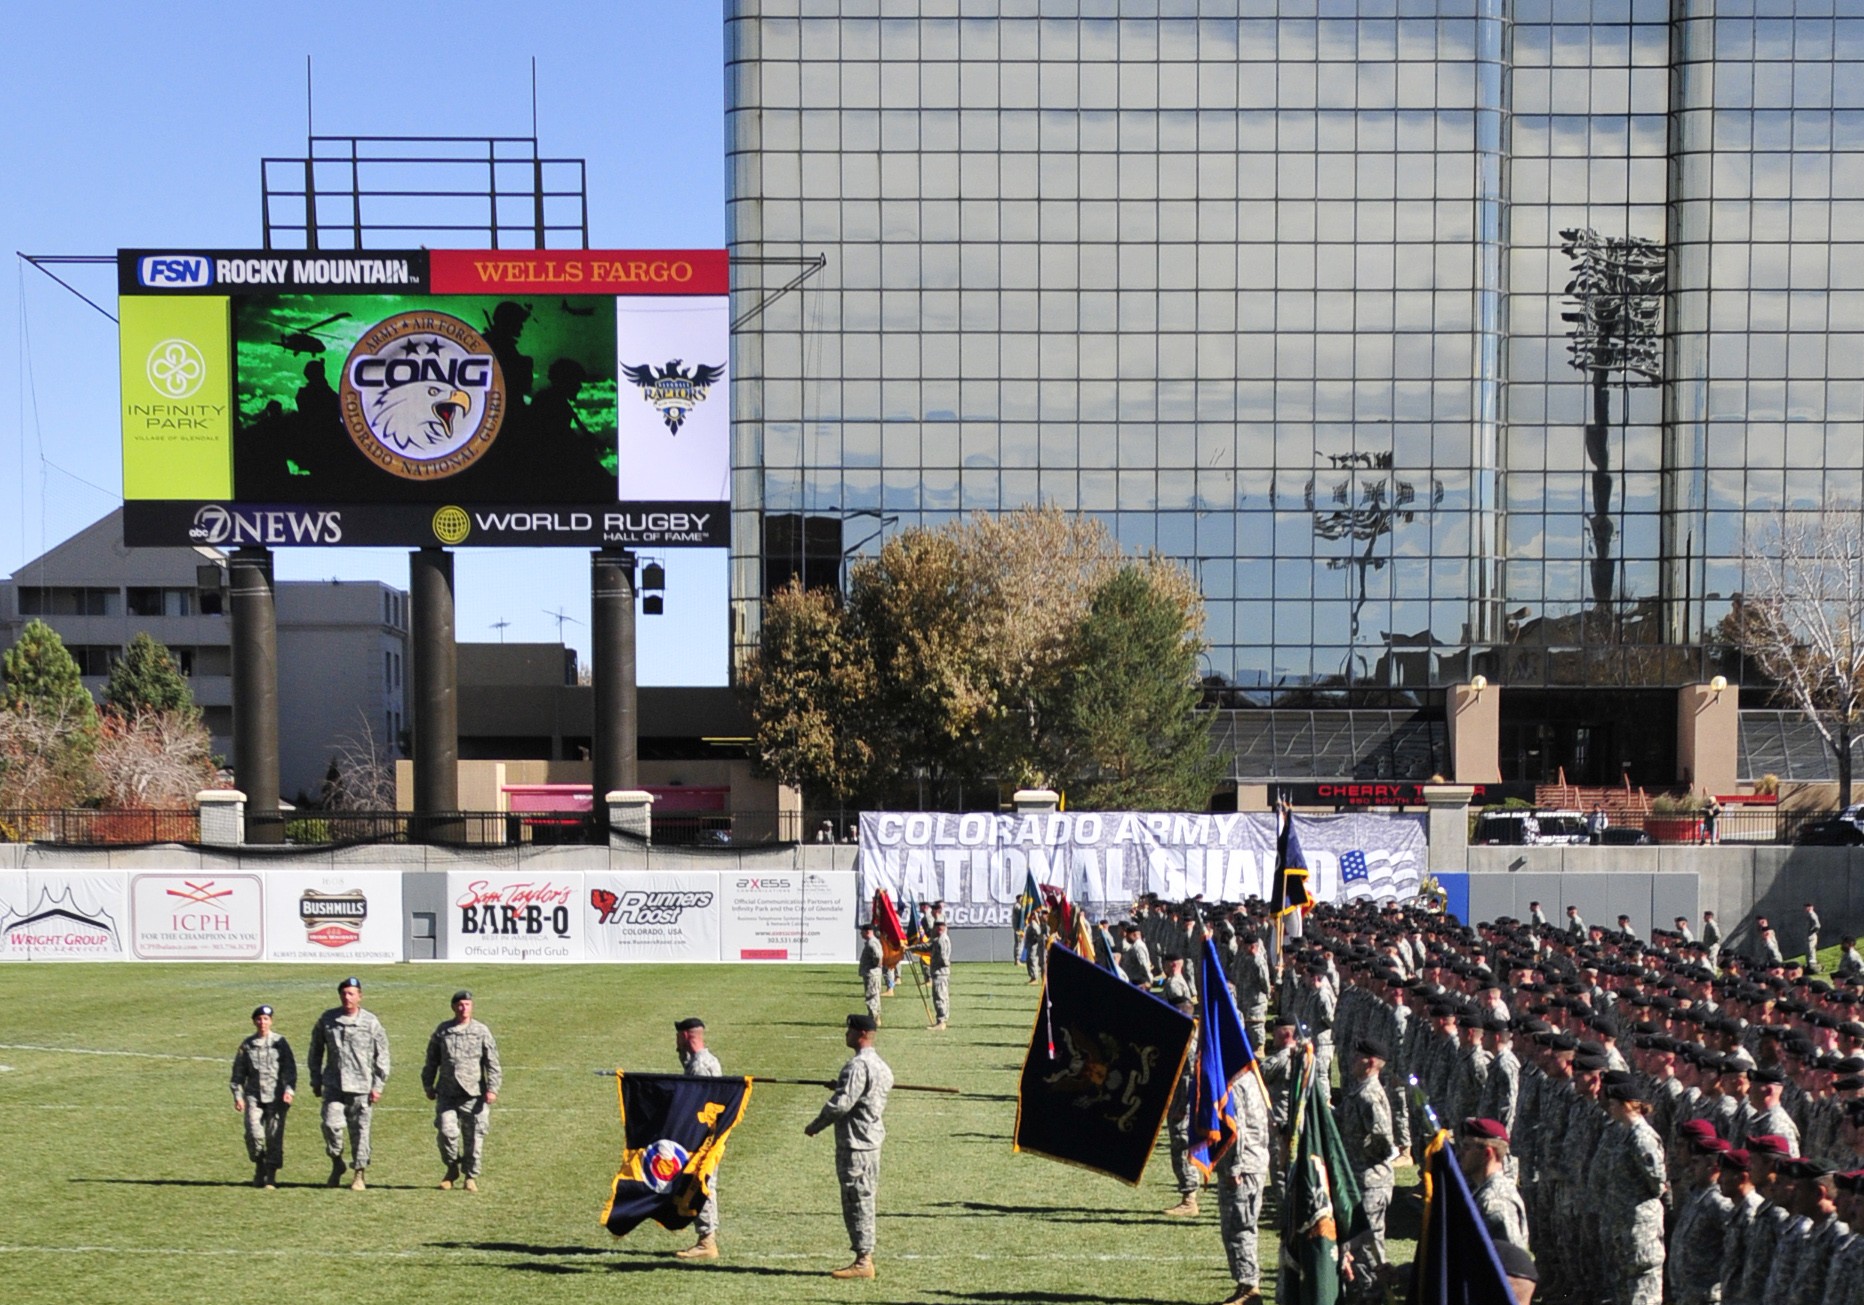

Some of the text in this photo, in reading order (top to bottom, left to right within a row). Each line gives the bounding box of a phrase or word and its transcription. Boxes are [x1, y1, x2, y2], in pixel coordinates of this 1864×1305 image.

[150, 260, 408, 284] FSN ROCKY MOUNTAIN
[474, 261, 693, 282] WELLS FARGO
[365, 317, 482, 352] ARMY AIR FORCE
[354, 358, 490, 389] CONG
[128, 404, 226, 416] INFINITY
[146, 418, 208, 429] PARK
[346, 391, 502, 477] COLORADO NATIONAL GUARD
[188, 527, 209, 538] abc
[232, 511, 342, 543] NEWS
[475, 513, 711, 531] WORLD RUGBY
[603, 532, 702, 542] HALL OF FAME
[1318, 785, 1401, 797] CHERRY
[1374, 797, 1410, 805] SOUTH
[877, 813, 1241, 846] COLORADO ARMY
[863, 848, 1337, 904] NATIONAL GUAD
[456, 880, 503, 909] Sam
[610, 891, 713, 918] Runners
[302, 900, 365, 915] BUSHMILLS
[172, 914, 230, 931] ICPH
[461, 905, 571, 939] BAR-B-Q
[464, 945, 499, 956] Official
[501, 946, 521, 956] Pub
[544, 946, 569, 956] Grub
